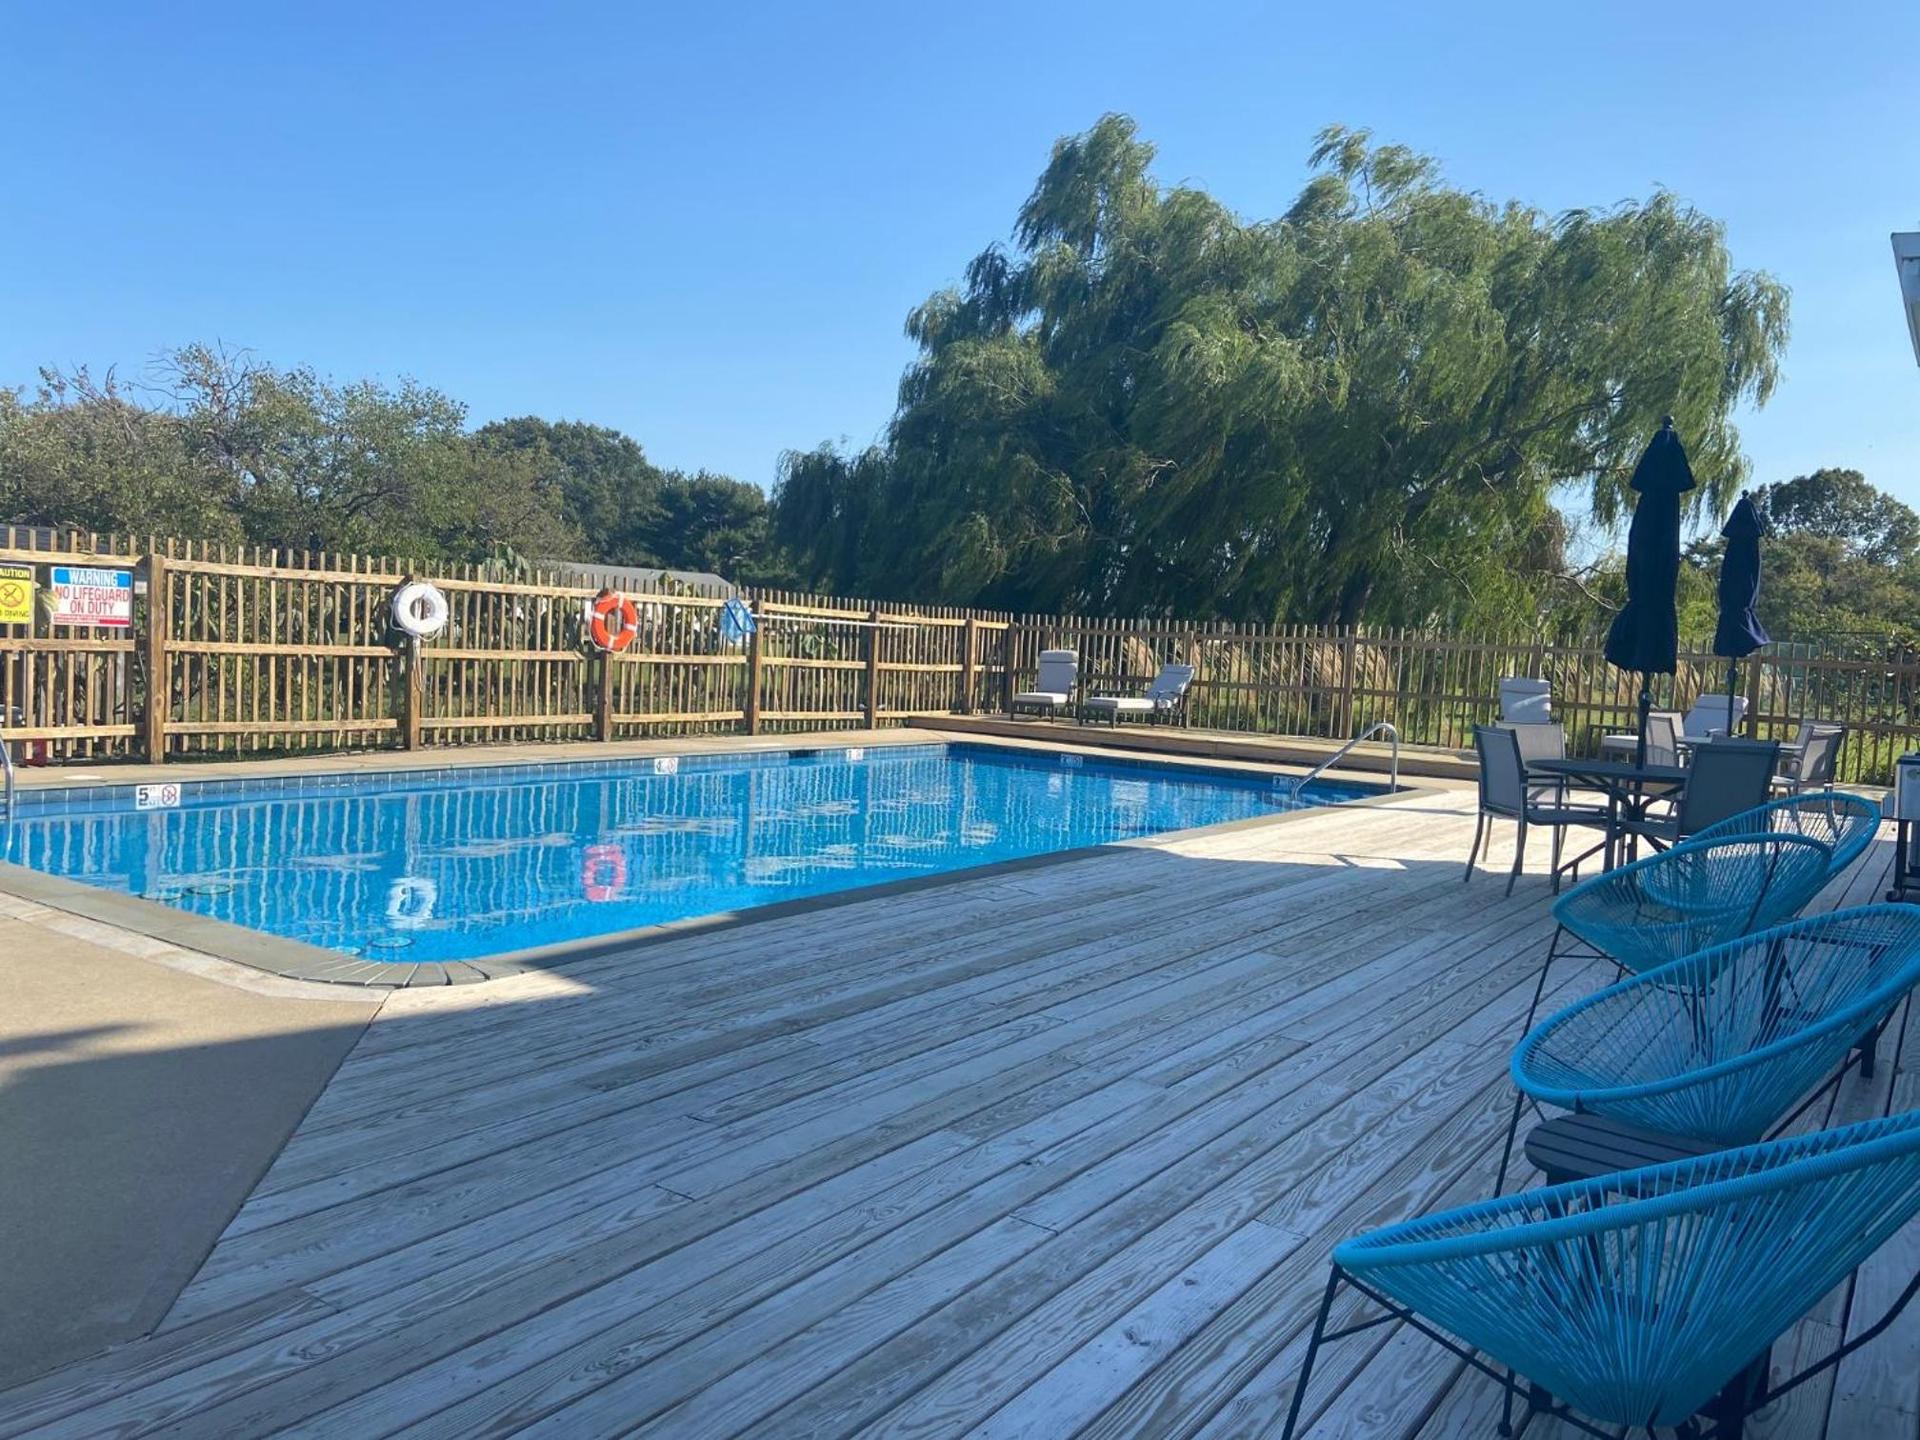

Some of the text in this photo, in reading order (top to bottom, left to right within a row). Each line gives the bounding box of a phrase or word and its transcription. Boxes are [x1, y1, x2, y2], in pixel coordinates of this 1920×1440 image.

[0, 568, 30, 579] AUTION
[70, 569, 118, 586] WARNING
[54, 586, 129, 602] NO LIFEGUARD
[4, 610, 29, 618] DIVING
[70, 601, 115, 614] ON DUTY
[139, 787, 149, 806] 5
